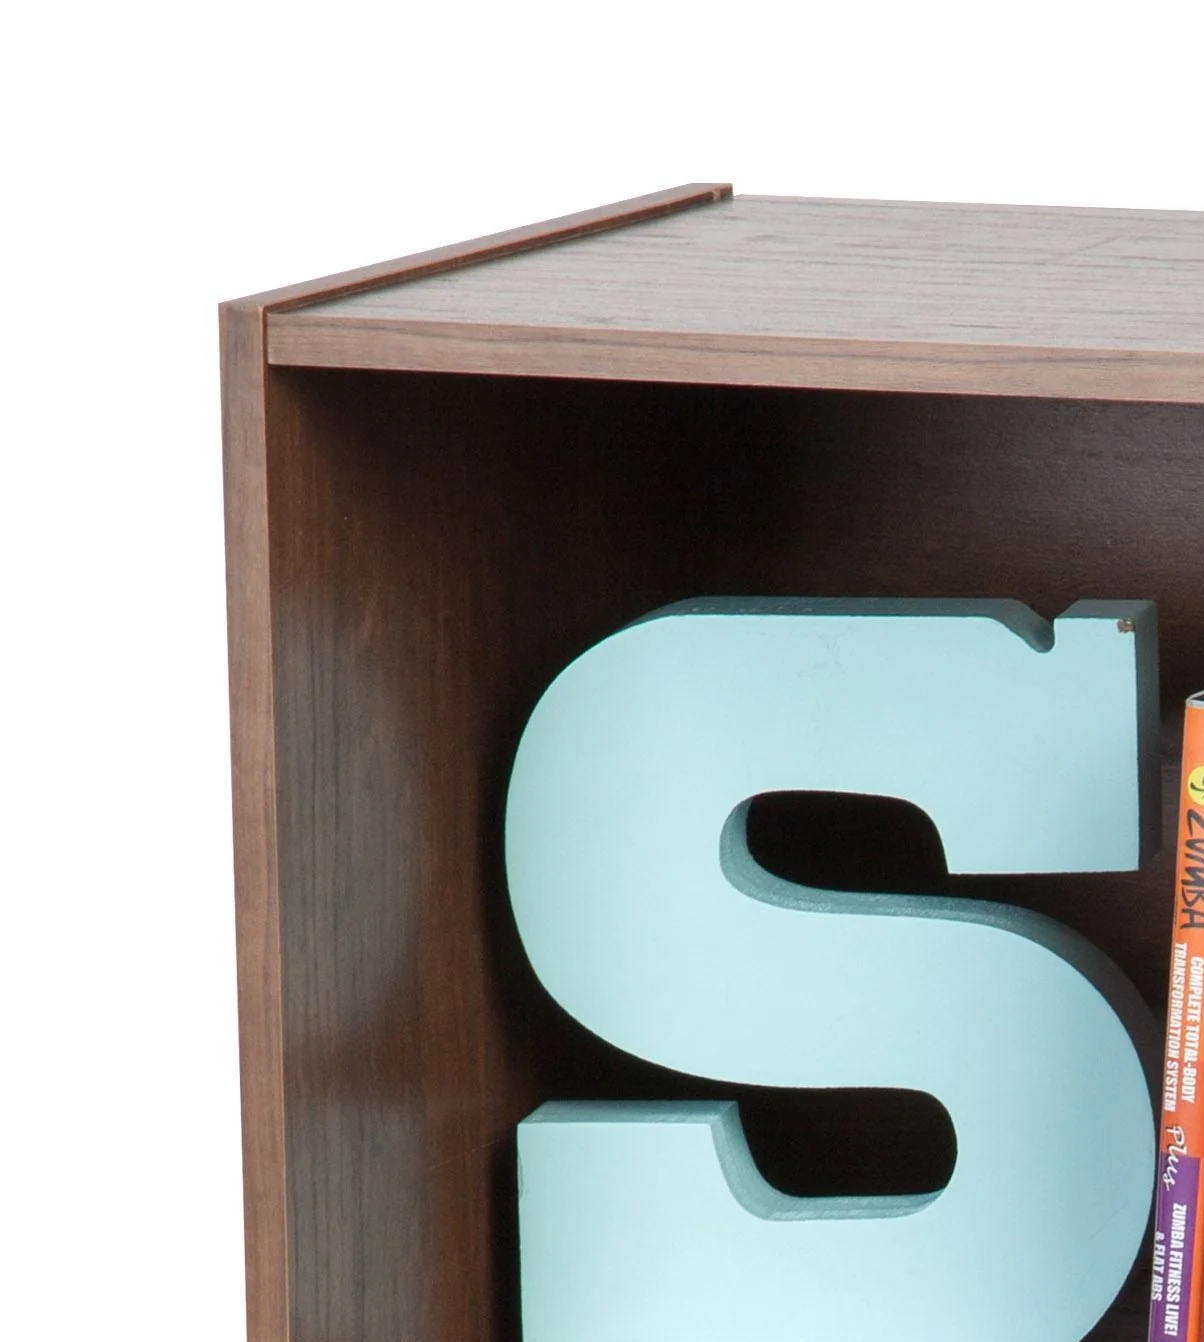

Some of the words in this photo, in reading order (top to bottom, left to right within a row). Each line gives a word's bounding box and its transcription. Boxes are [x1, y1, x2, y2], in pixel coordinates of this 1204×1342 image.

[1167, 943, 1187, 1058] TRANSFORMATION
[1186, 956, 1204, 1021] COMPLETE
[1164, 1060, 1179, 1112] SYSTEM
[1181, 1024, 1201, 1104] TOTAL-BODY
[1163, 1126, 1188, 1191] Plus
[1155, 1231, 1165, 1241] &
[1169, 1204, 1187, 1249] ZUMBA
[1153, 1244, 1164, 1276] FLAT
[1166, 1250, 1184, 1303] FITNESS
[1152, 1277, 1164, 1301] ABS
[1164, 1305, 1180, 1337] LIVE!
